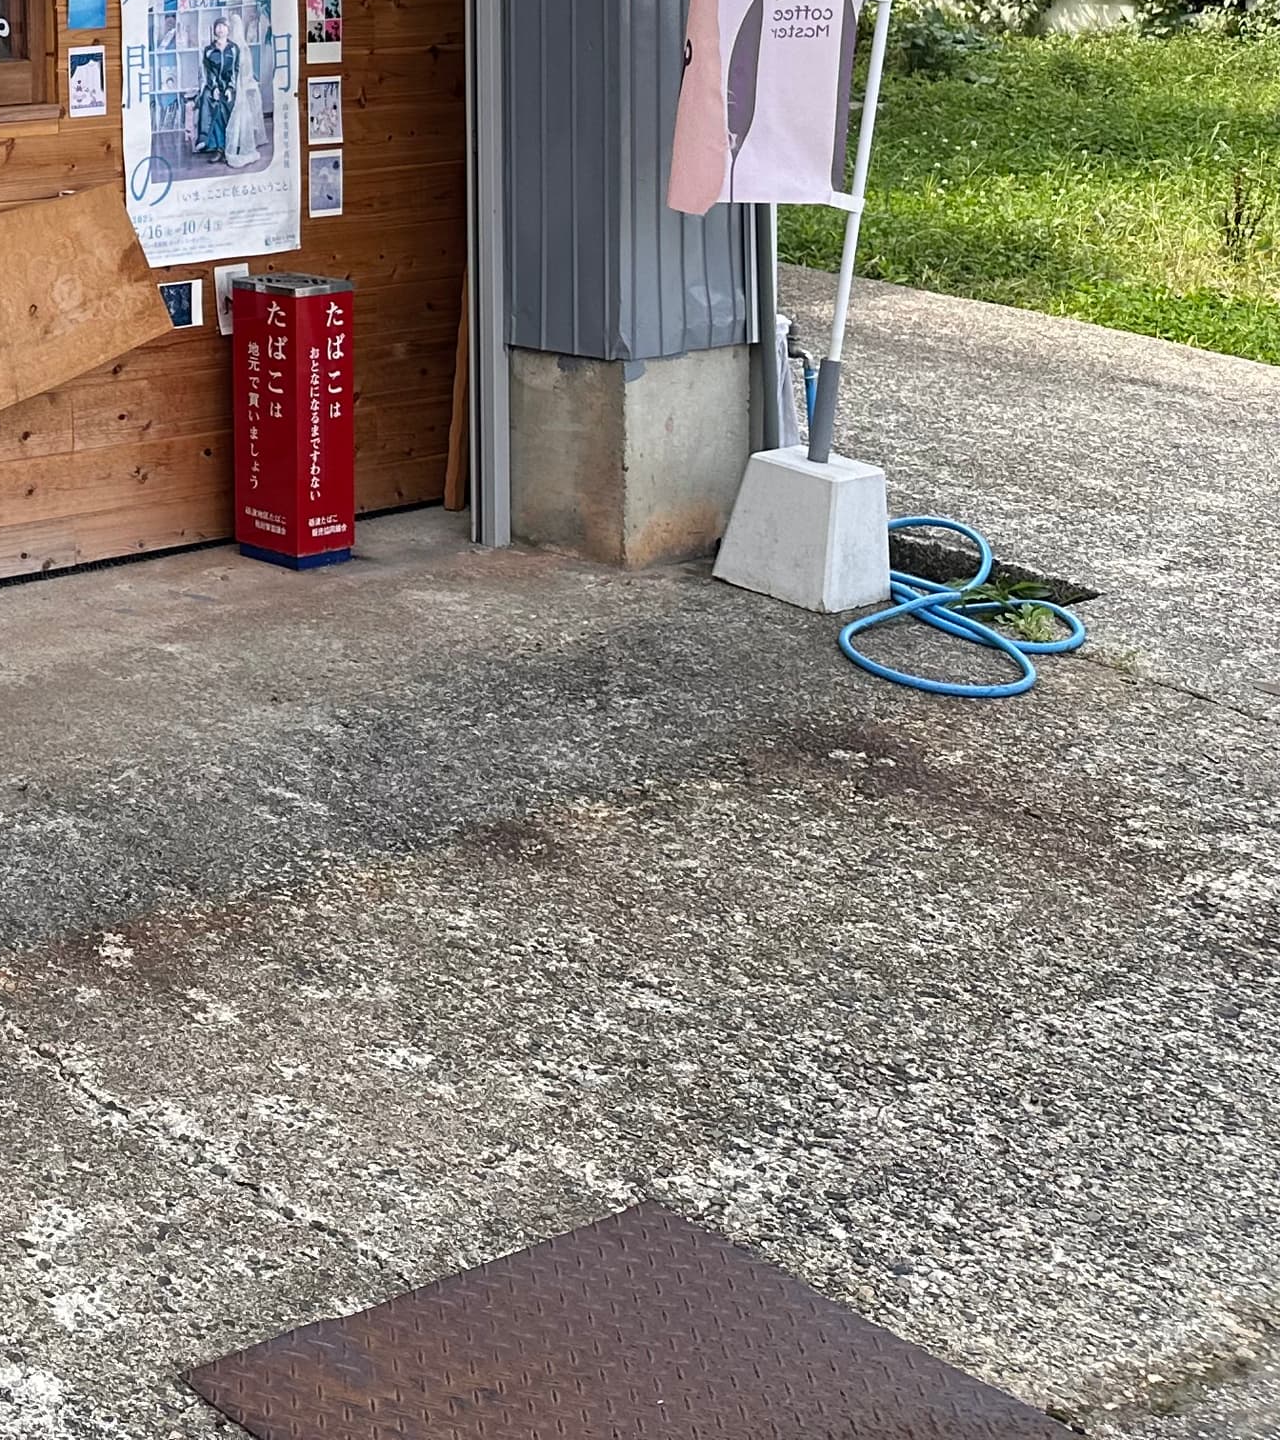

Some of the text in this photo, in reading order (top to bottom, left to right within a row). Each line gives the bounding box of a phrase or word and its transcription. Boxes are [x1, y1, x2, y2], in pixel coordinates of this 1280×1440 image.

[248, 341, 260, 489] 地元で買いましょう
[267, 301, 288, 418] たばこは
[309, 347, 321, 501] おとなになるまですわない
[325, 301, 345, 418] たばこは
